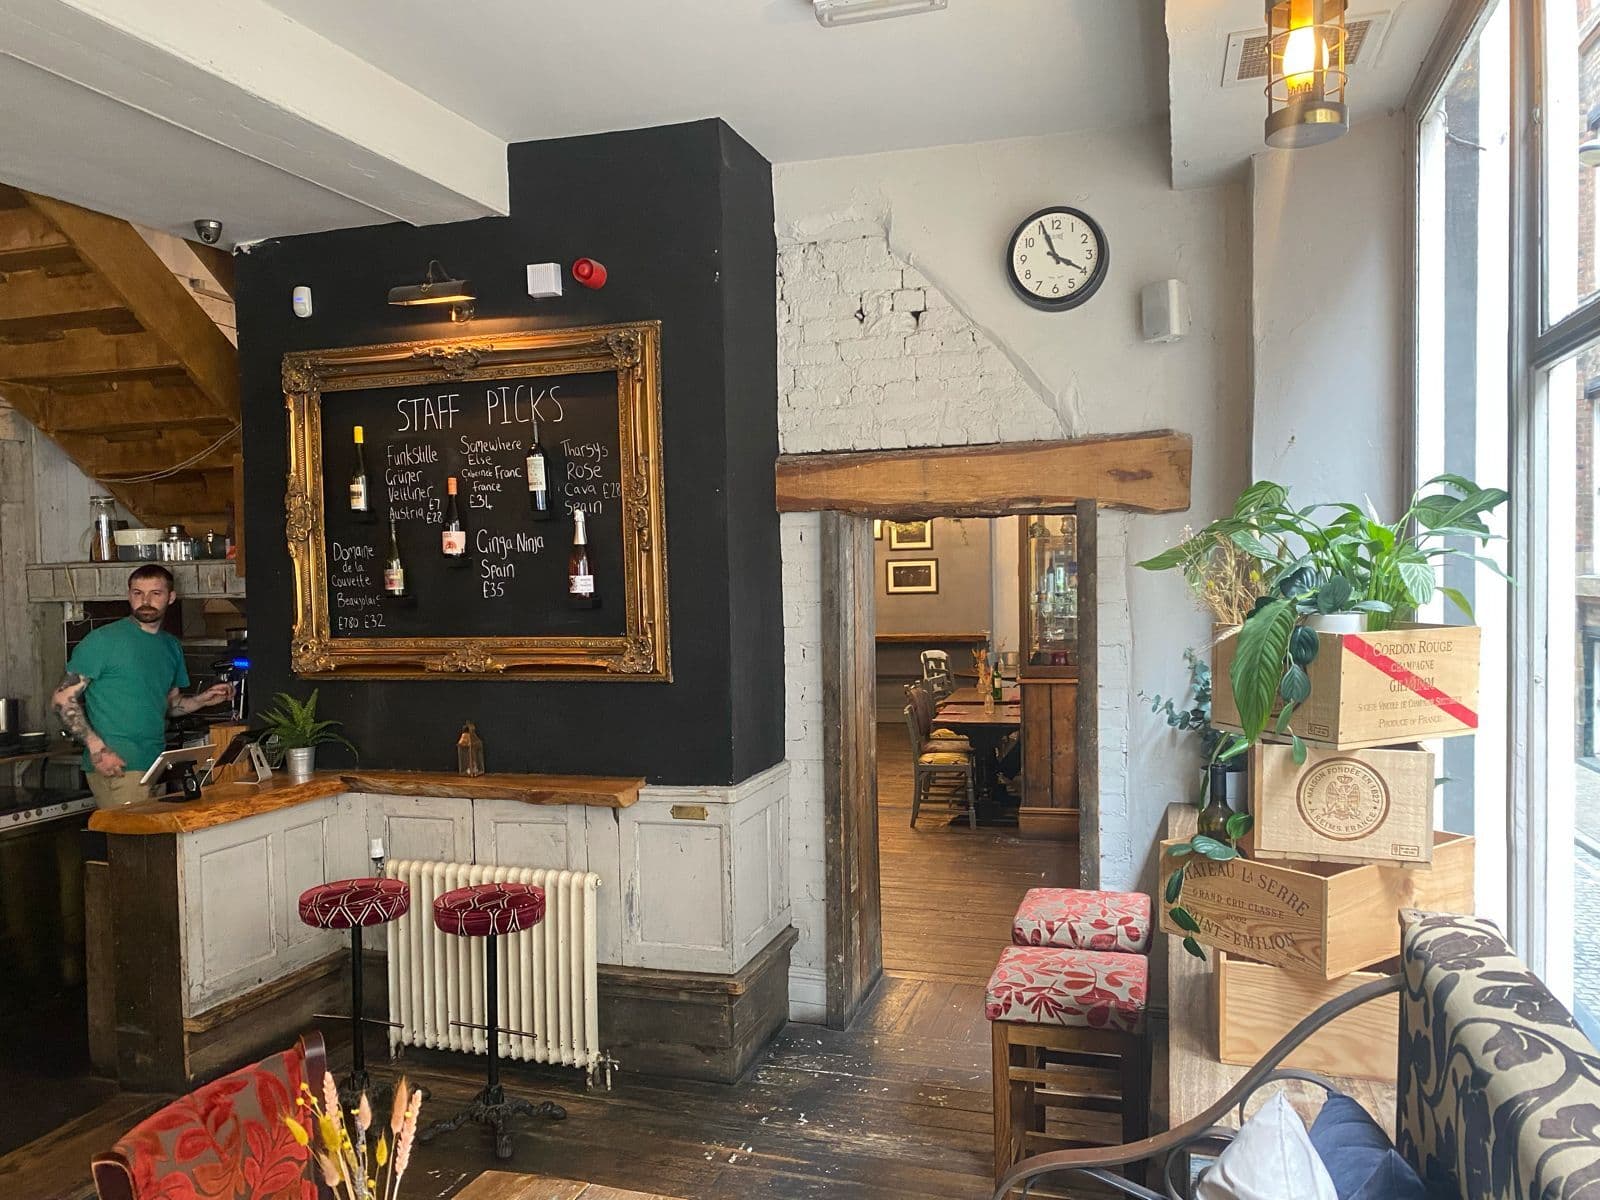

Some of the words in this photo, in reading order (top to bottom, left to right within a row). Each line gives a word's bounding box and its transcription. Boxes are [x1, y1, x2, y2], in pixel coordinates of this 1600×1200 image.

[1051, 219, 1062, 230] 12
[1071, 222, 1074, 233] 1
[1025, 237, 1035, 248] 10
[1081, 233, 1088, 244] 2
[1020, 254, 1028, 265] 9
[1086, 249, 1093, 260] 3
[1024, 269, 1032, 280] 8
[1079, 266, 1088, 276] 4
[1036, 280, 1043, 291] 7
[1052, 284, 1060, 294] 6
[1068, 278, 1075, 289] 5
[397, 394, 460, 432] STAFF
[487, 385, 564, 425] PICKS
[460, 435, 523, 455] Somewhere
[560, 438, 609, 462] Tharsys
[468, 454, 493, 466] Else
[385, 468, 424, 487] Grüner
[494, 465, 523, 479] Franc
[564, 483, 597, 497] Cava
[469, 494, 494, 510] £34
[564, 499, 603, 516] Spain
[389, 506, 425, 520] Austria
[476, 528, 513, 560] Ginga
[516, 532, 544, 554] Ninja
[332, 542, 375, 561] Domaine
[342, 561, 352, 573] de
[354, 562, 365, 572] la
[481, 559, 515, 580] Spain
[483, 580, 506, 598] £35
[1373, 642, 1417, 657] CORDON
[1419, 640, 1453, 654] ROUGE
[1345, 812, 1377, 832] FRANCE
[1184, 860, 1235, 881] HATEAU
[1257, 873, 1310, 917] SERRE
[1192, 888, 1223, 903] GRAND
[1226, 897, 1245, 909] CRU
